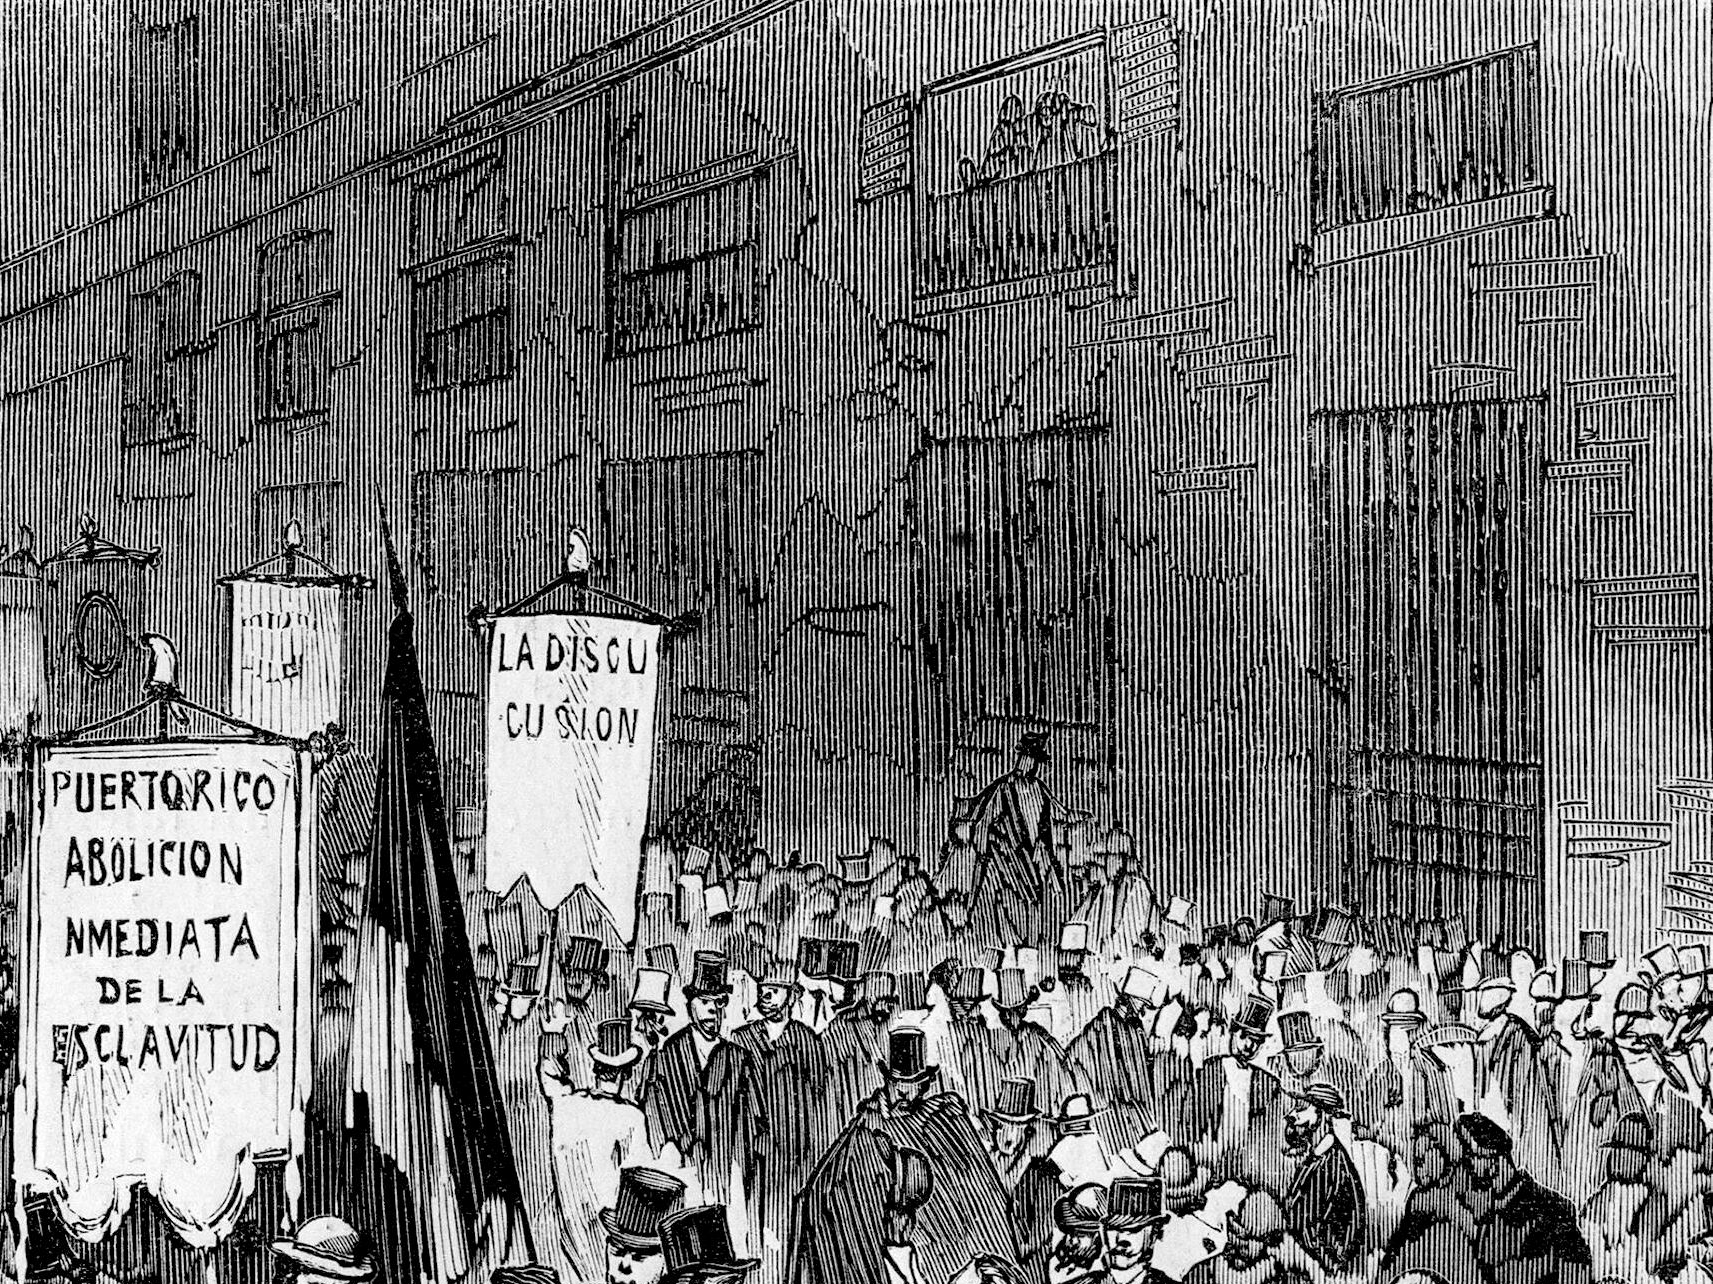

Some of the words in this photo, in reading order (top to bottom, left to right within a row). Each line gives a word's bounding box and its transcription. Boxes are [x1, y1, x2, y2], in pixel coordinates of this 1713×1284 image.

[64, 836, 243, 888] ABOLICION
[65, 912, 260, 963] NMEDIATA
[95, 976, 142, 1005] DE
[158, 977, 205, 1006] LA
[52, 1022, 281, 1073] ESCLAVITUD
